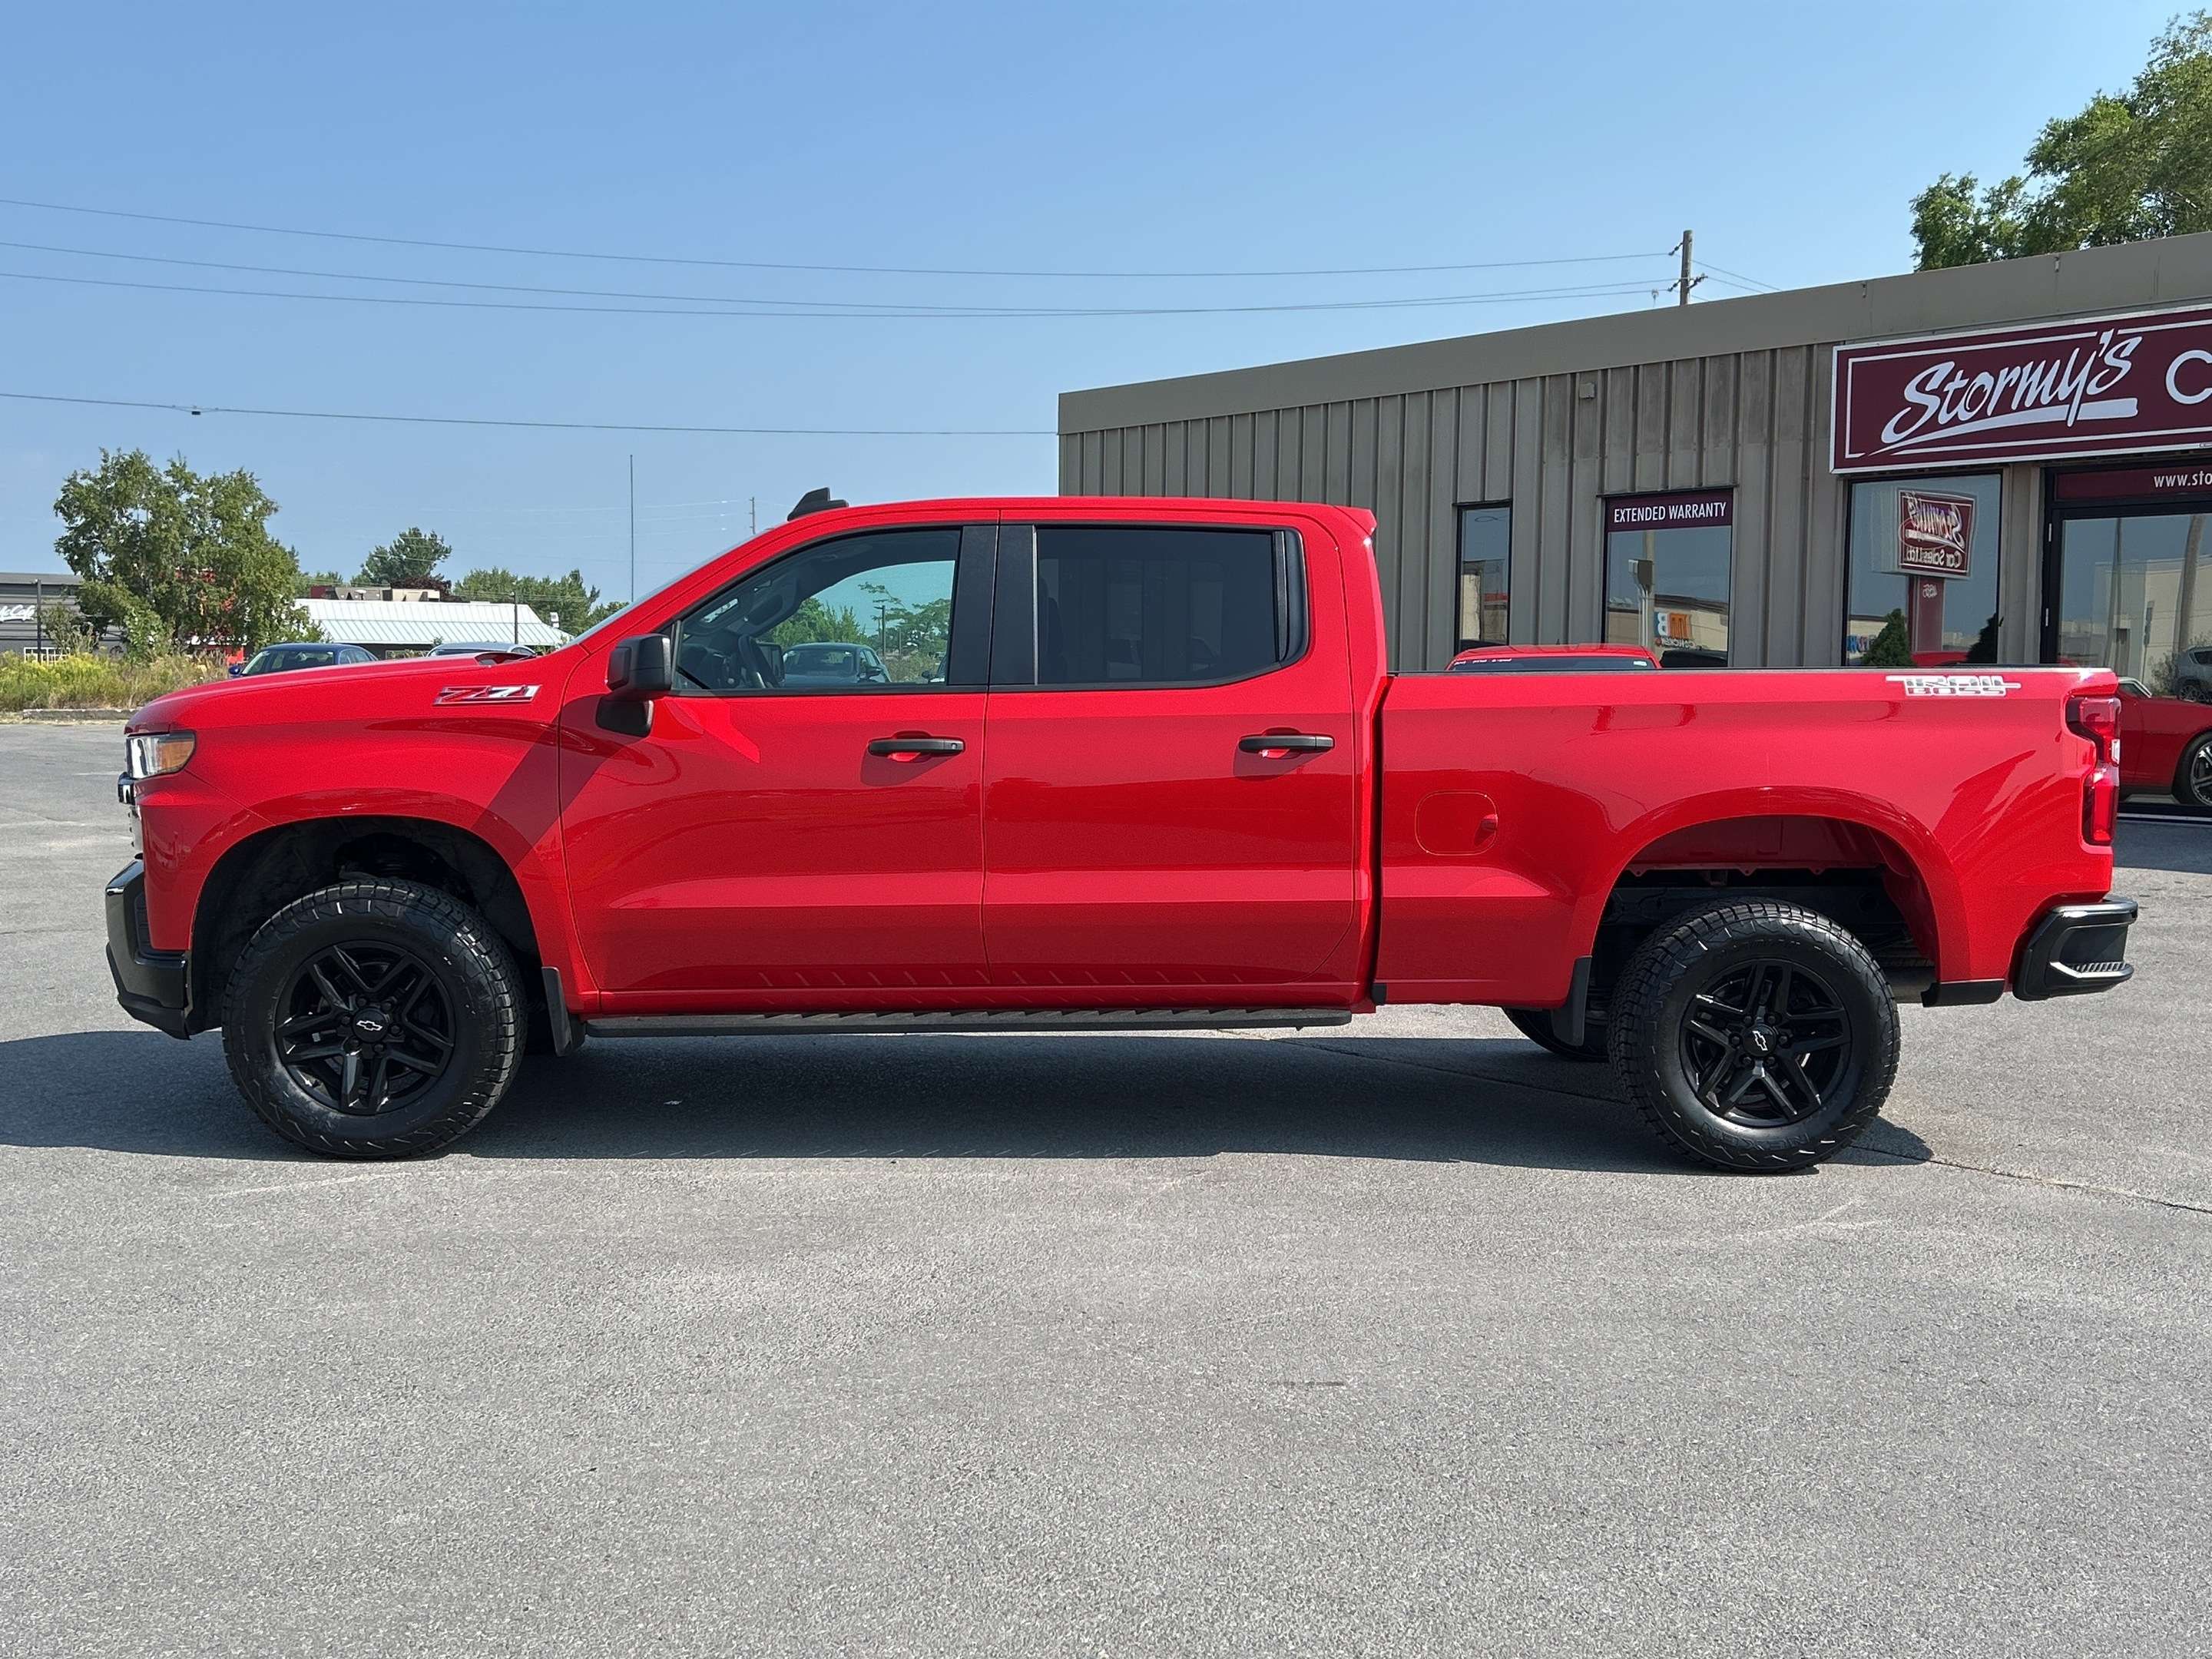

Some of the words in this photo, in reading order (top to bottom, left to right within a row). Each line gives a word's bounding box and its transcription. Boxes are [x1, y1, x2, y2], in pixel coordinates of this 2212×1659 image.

[1880, 328, 2143, 443] Stormy's
[2165, 349, 2212, 406] C
[1614, 505, 1666, 524] EXTENDED
[1668, 502, 1727, 521] WARRANTY
[433, 684, 542, 706] Z71
